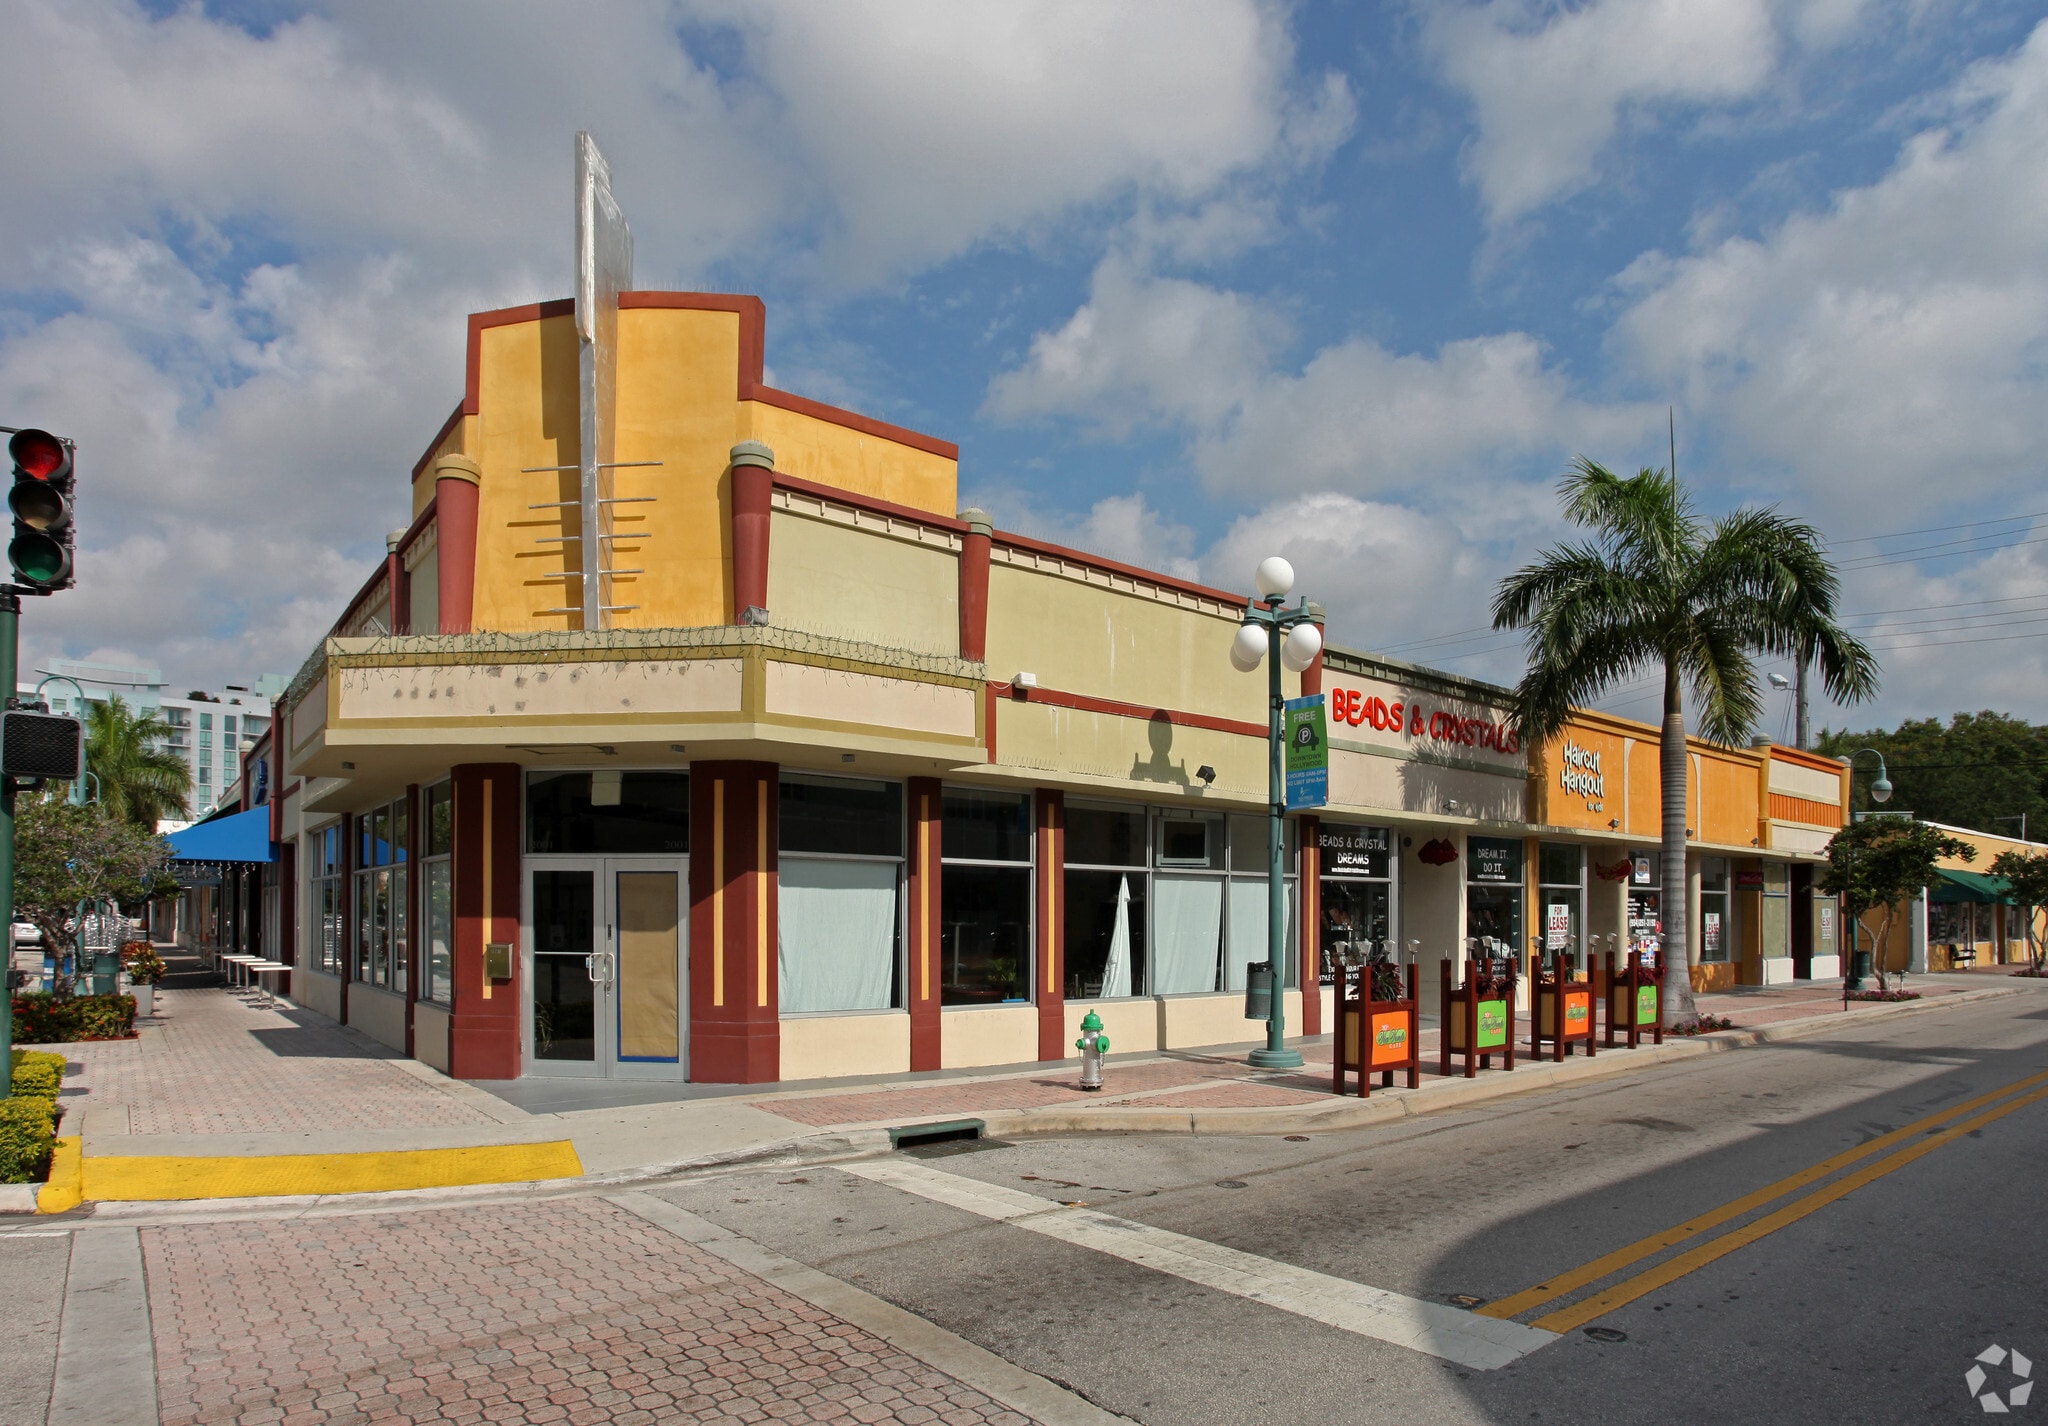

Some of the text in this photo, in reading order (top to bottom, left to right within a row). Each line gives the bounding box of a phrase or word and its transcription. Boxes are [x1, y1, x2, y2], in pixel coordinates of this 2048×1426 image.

[1293, 710, 1316, 723] FREE
[1333, 688, 1520, 754] BEADS & CRYSTALS
[1291, 753, 1321, 763] DOWNTOWN
[1563, 738, 1601, 775] Haircut
[1290, 760, 1322, 769] HOLLYWOOD
[1290, 771, 1306, 779] HOURS
[1560, 764, 1604, 798] Hangout
[1319, 834, 1387, 850] BEADS & CRYSTAL
[1337, 852, 1369, 865] DREAMS
[1478, 848, 1498, 860] DREAM
[1483, 863, 1504, 873] DO IT.
[1553, 906, 1563, 916] FOR
[1549, 916, 1568, 931] LEASE
